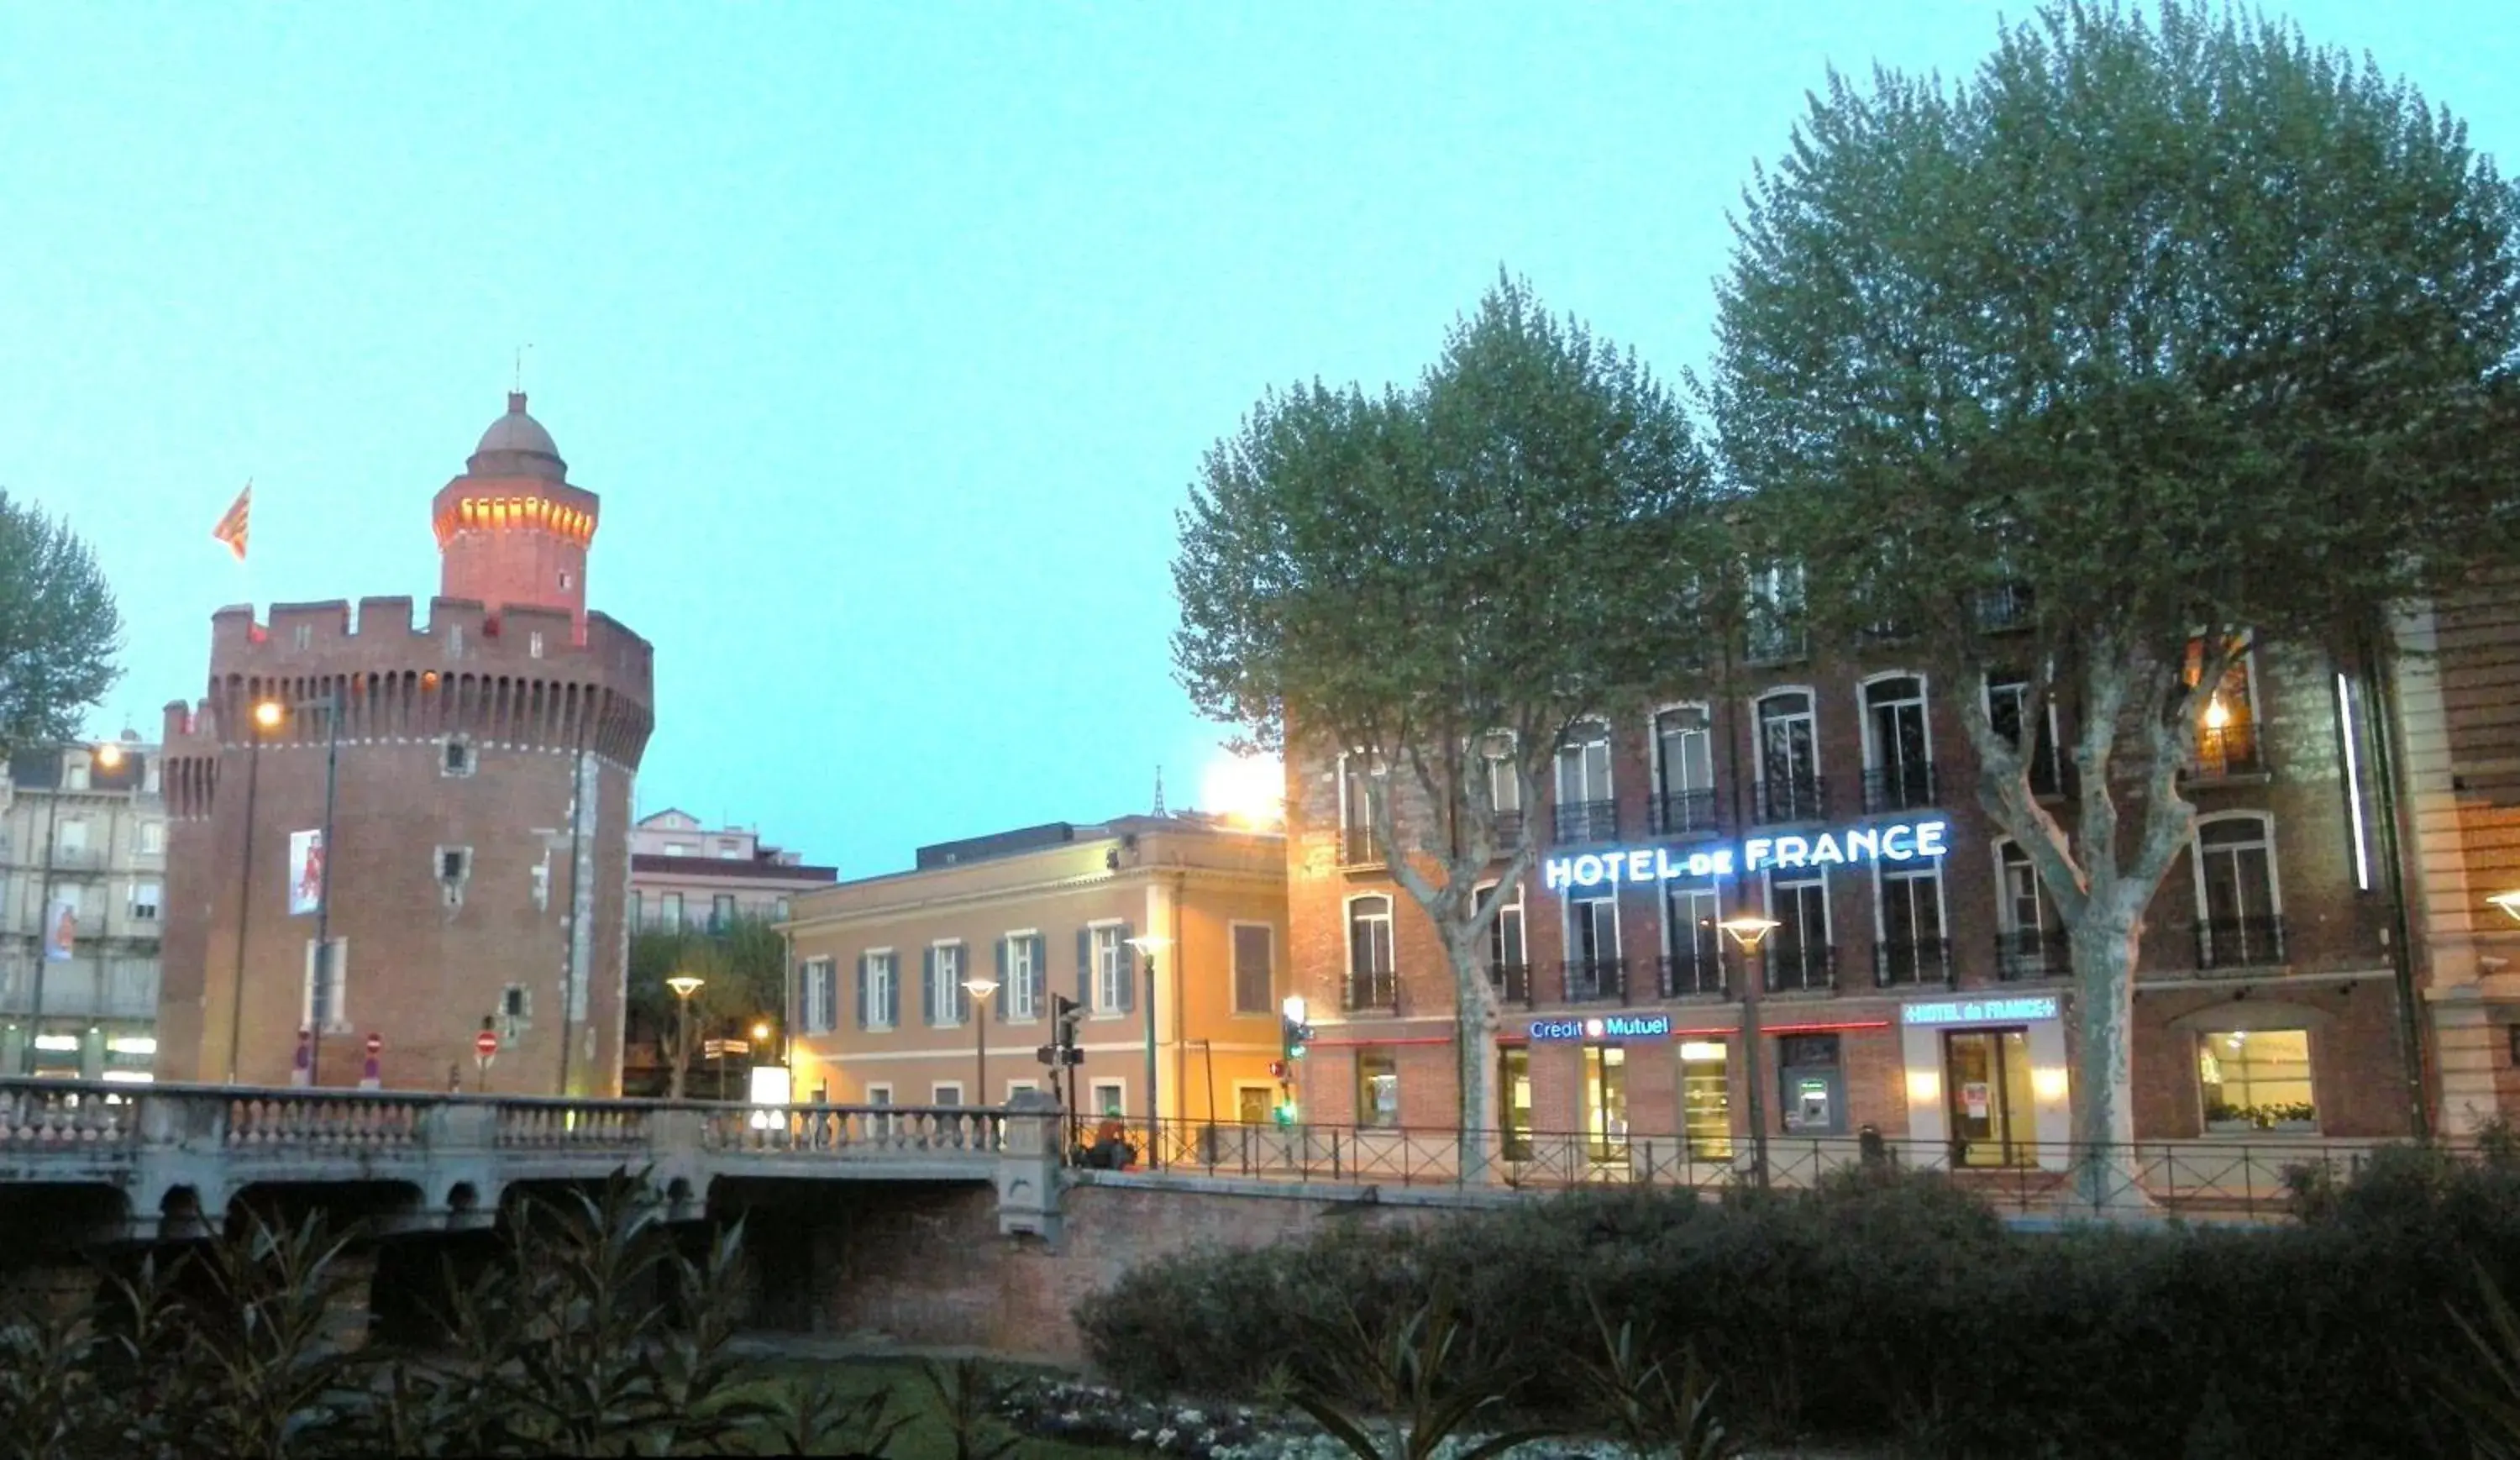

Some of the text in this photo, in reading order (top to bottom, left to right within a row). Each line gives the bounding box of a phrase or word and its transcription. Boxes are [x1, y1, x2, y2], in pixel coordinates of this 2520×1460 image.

[1546, 848, 1680, 890] HOTEL
[1745, 821, 1948, 871] FRANCE
[1530, 1015, 1668, 1038] Crédit Mutuel
